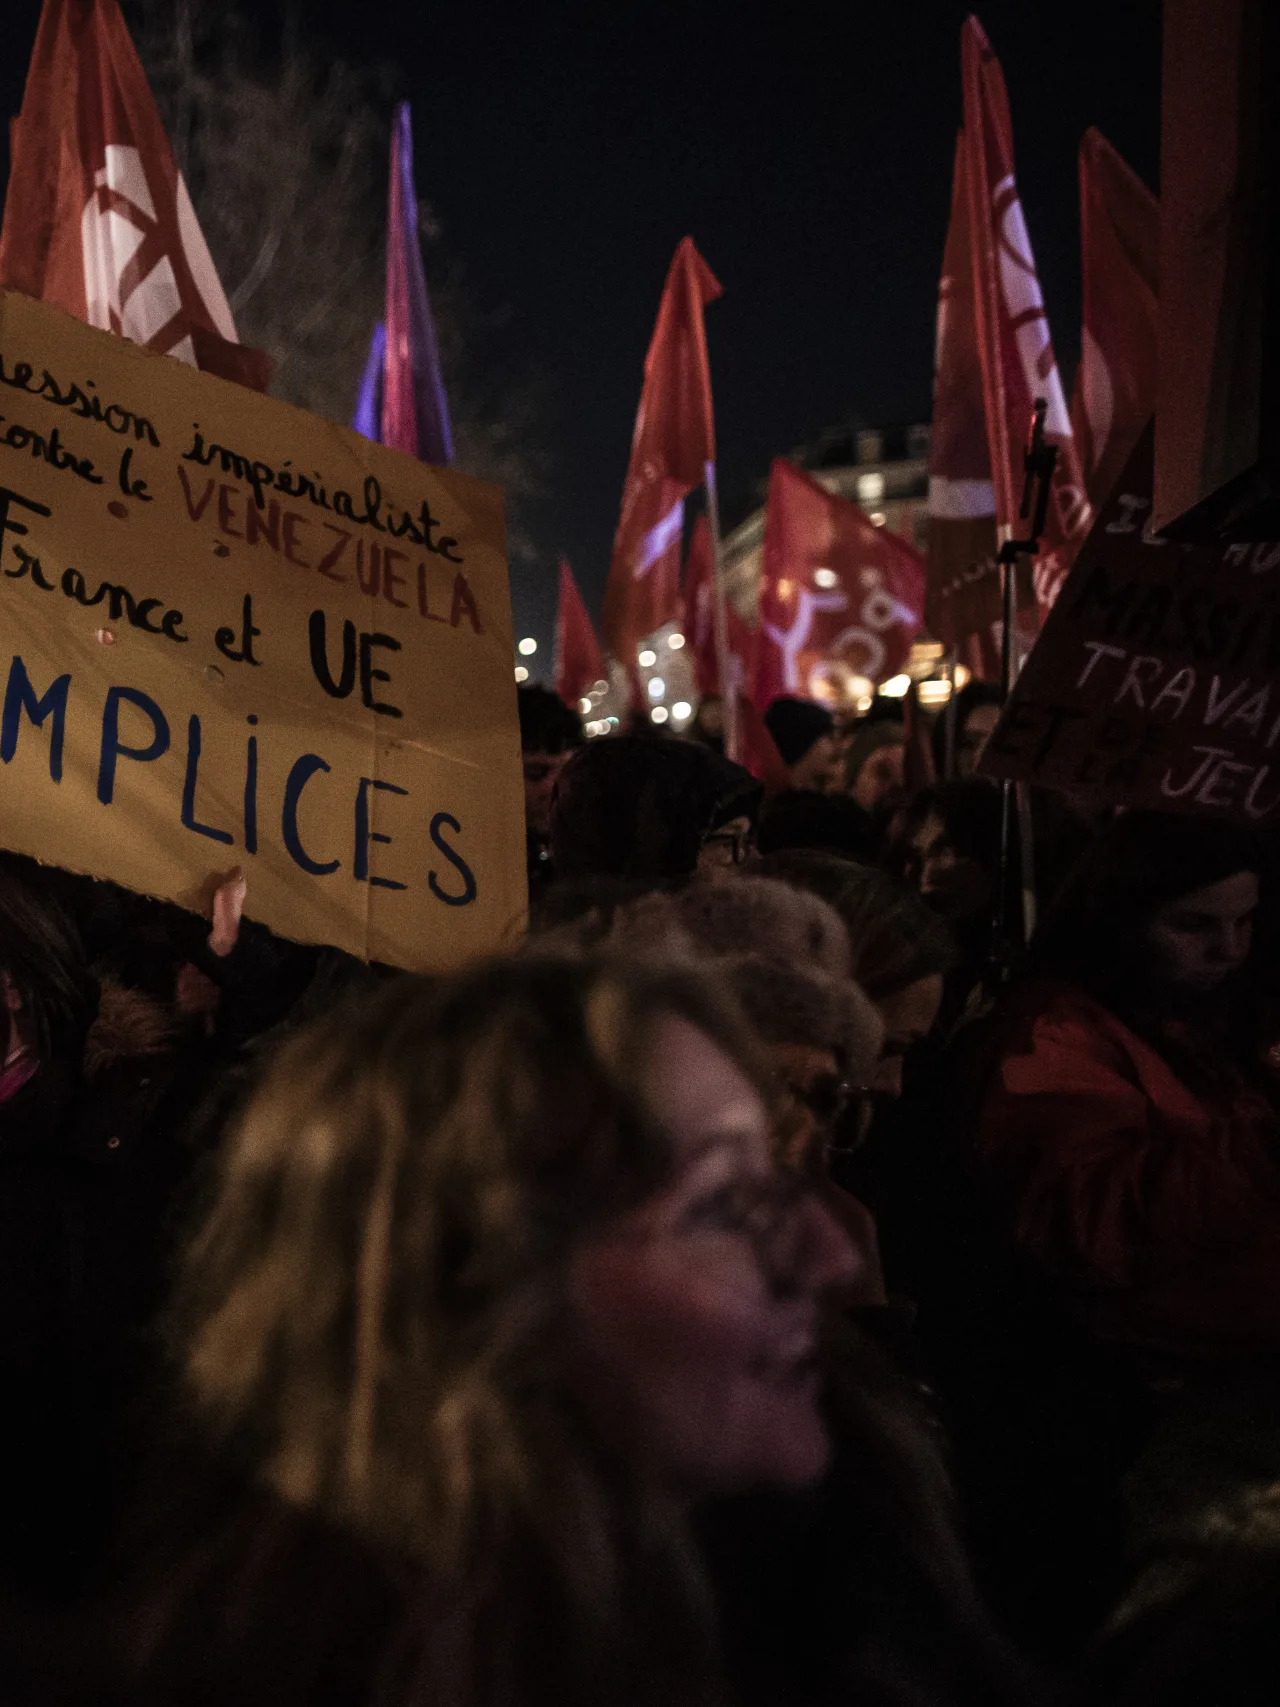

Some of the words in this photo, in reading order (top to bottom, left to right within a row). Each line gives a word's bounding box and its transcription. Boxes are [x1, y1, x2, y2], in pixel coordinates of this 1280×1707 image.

[120, 447, 153, 501] le
[177, 464, 484, 635] VENEZUELA
[182, 423, 463, 563] impérialiste
[215, 593, 262, 666] et
[309, 609, 403, 718] UE
